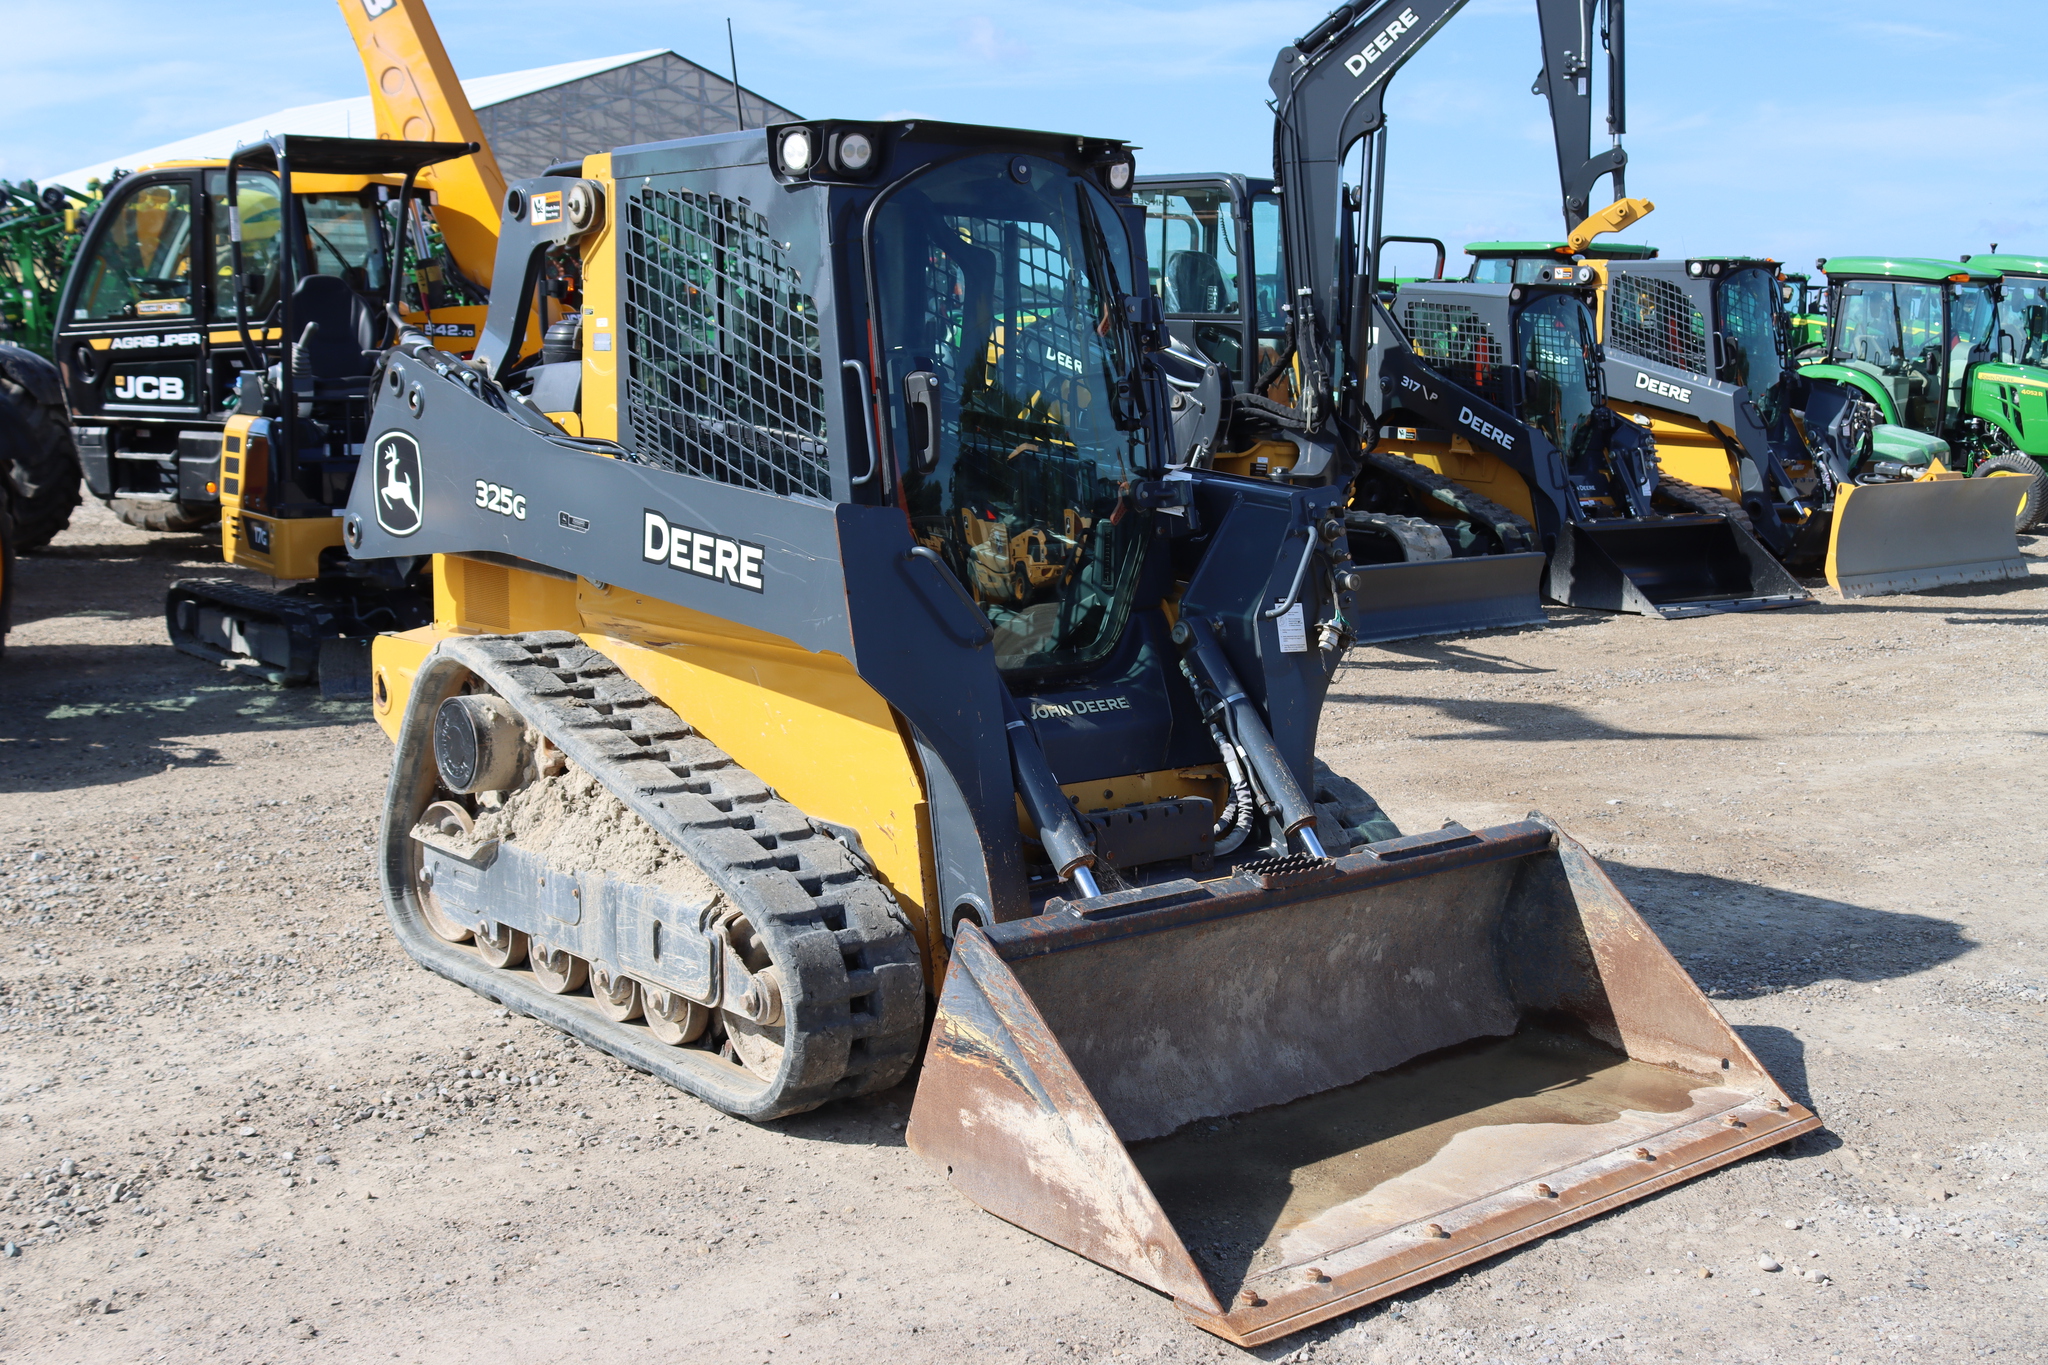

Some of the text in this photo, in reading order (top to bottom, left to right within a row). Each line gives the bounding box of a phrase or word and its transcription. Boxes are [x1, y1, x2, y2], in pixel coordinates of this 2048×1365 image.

[1344, 7, 1420, 78] DEERE
[1045, 346, 1083, 375] DEER
[115, 375, 184, 400] JCB
[1635, 371, 1692, 403] DEERE
[1458, 405, 1515, 451] DEERE
[475, 478, 527, 520] 325G
[643, 510, 764, 590] DEERE
[1031, 697, 1130, 720] JOHN DEERE
